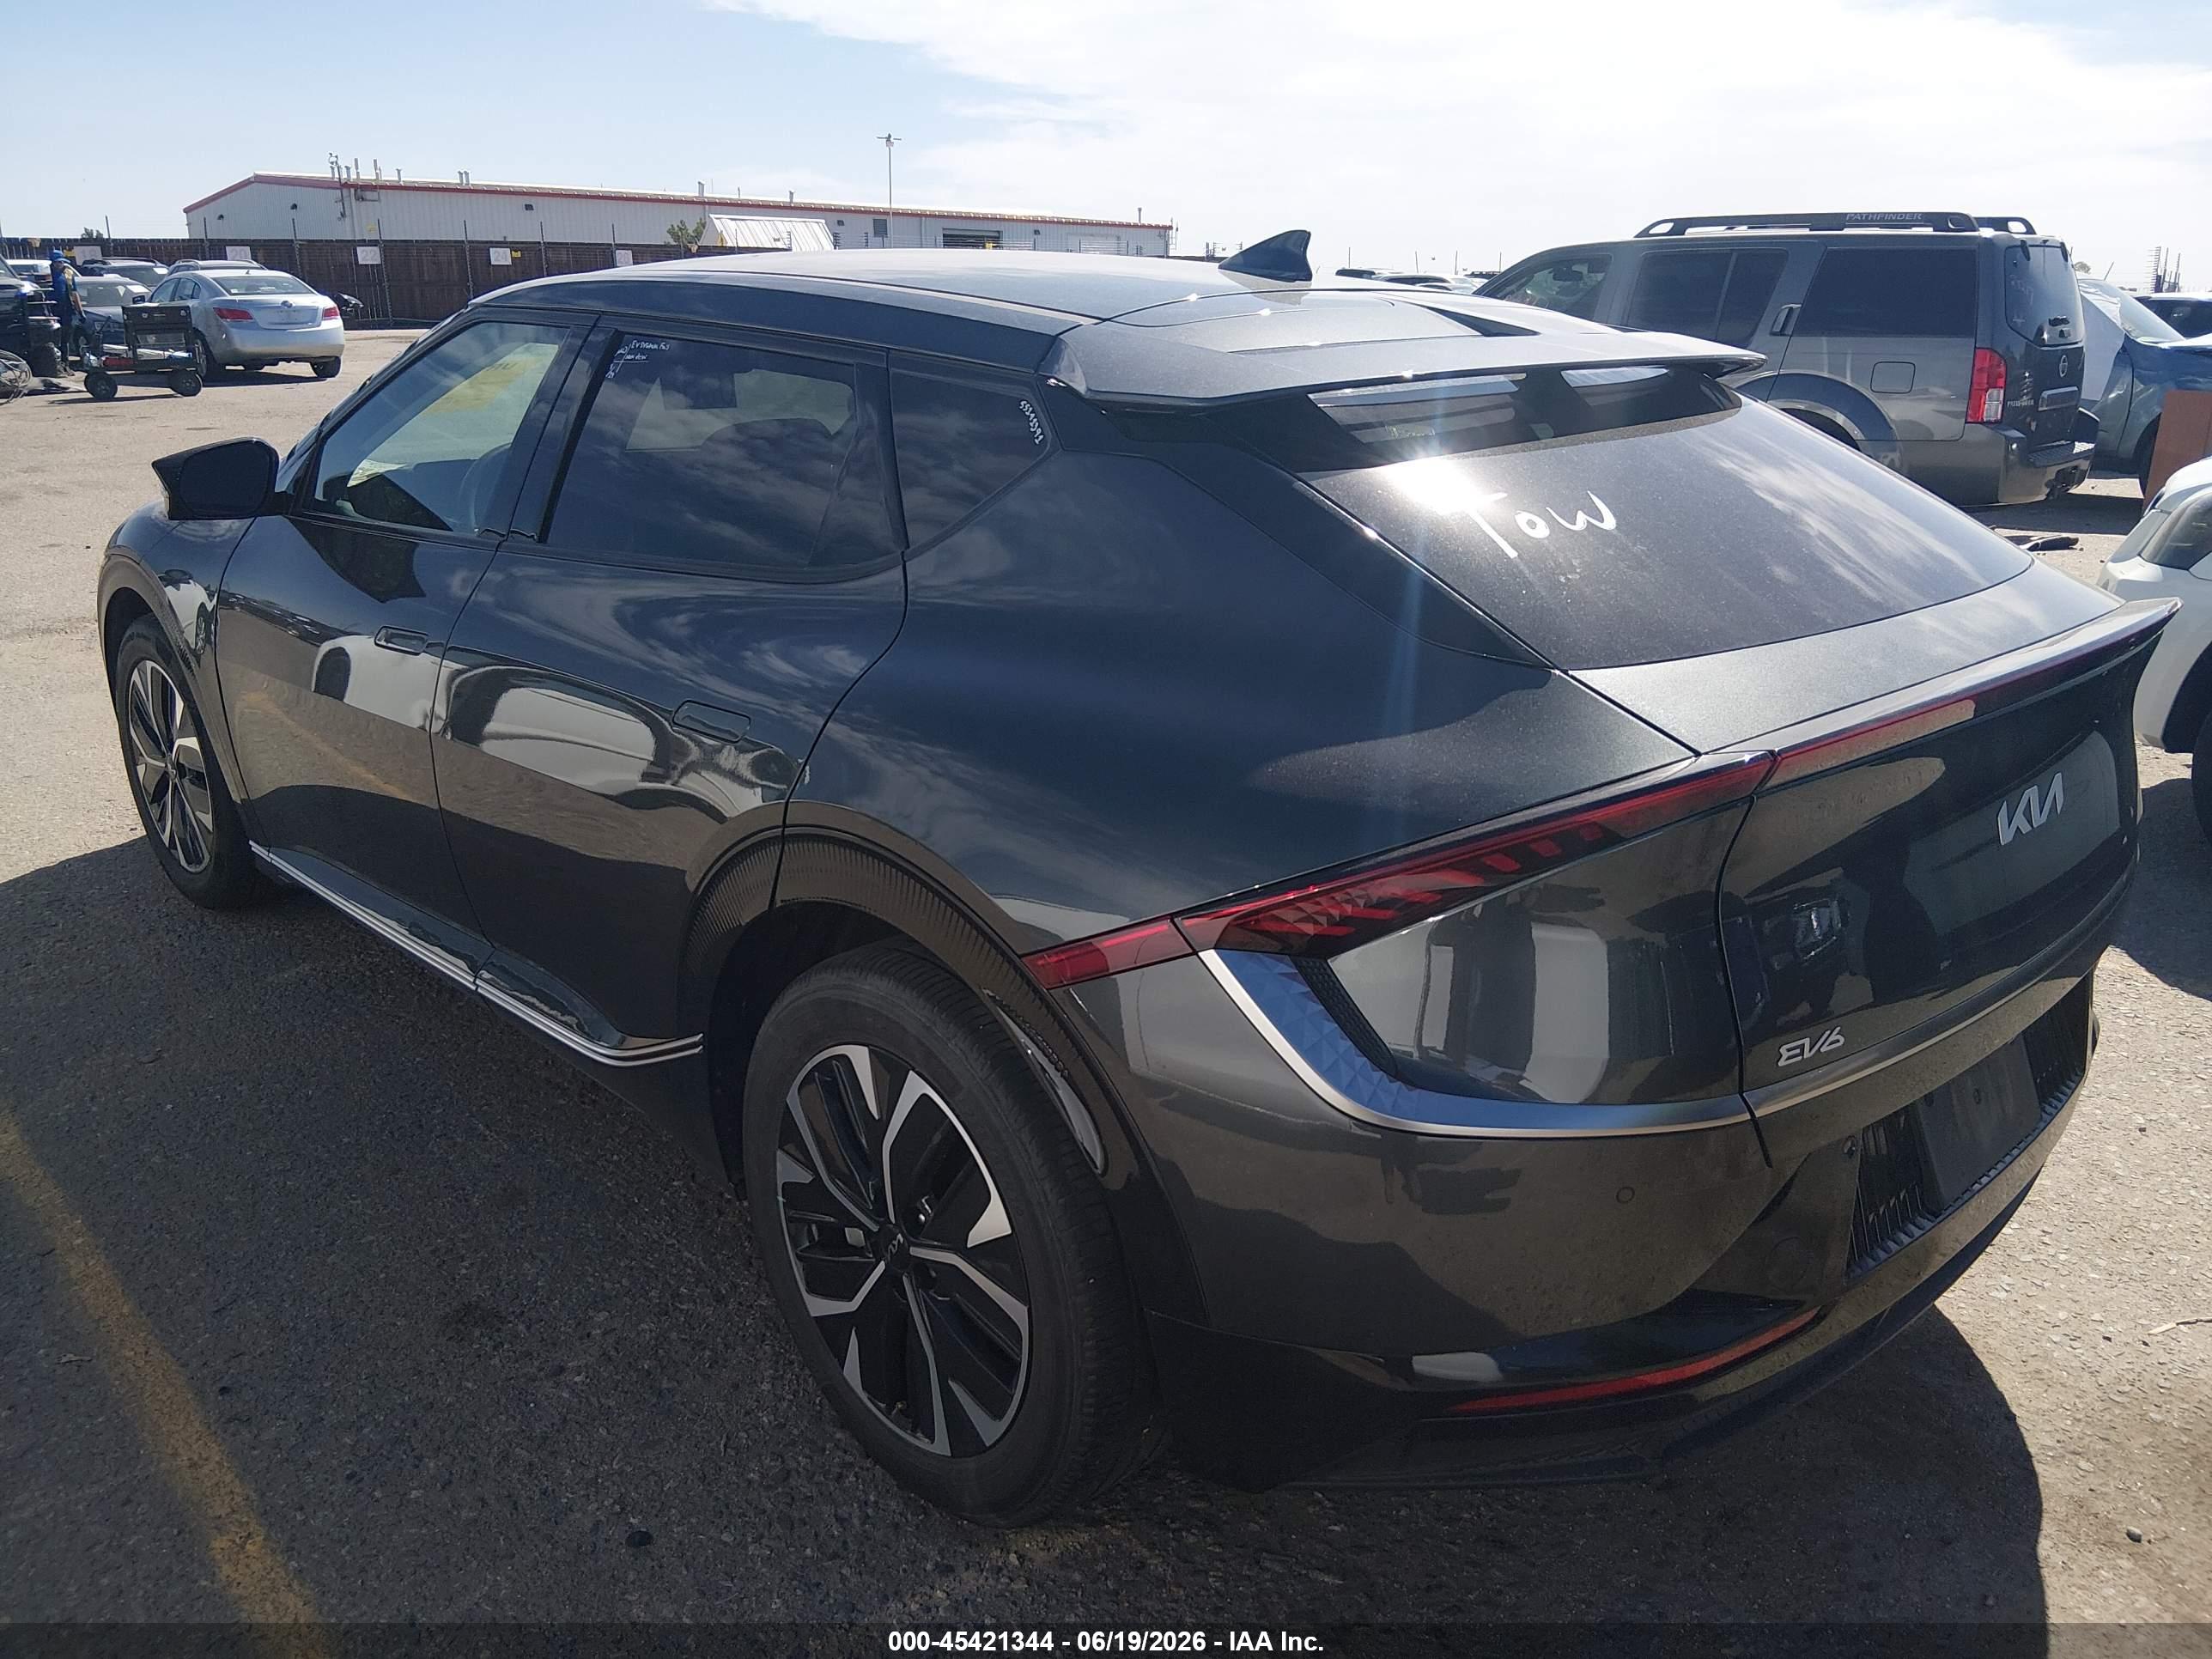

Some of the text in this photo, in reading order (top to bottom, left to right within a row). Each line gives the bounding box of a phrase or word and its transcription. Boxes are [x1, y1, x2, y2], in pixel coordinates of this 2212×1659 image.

[361, 249, 379, 262] 22
[494, 249, 508, 262] 24
[1997, 772, 2064, 846] KIA
[1778, 1026, 1845, 1066] EV6
